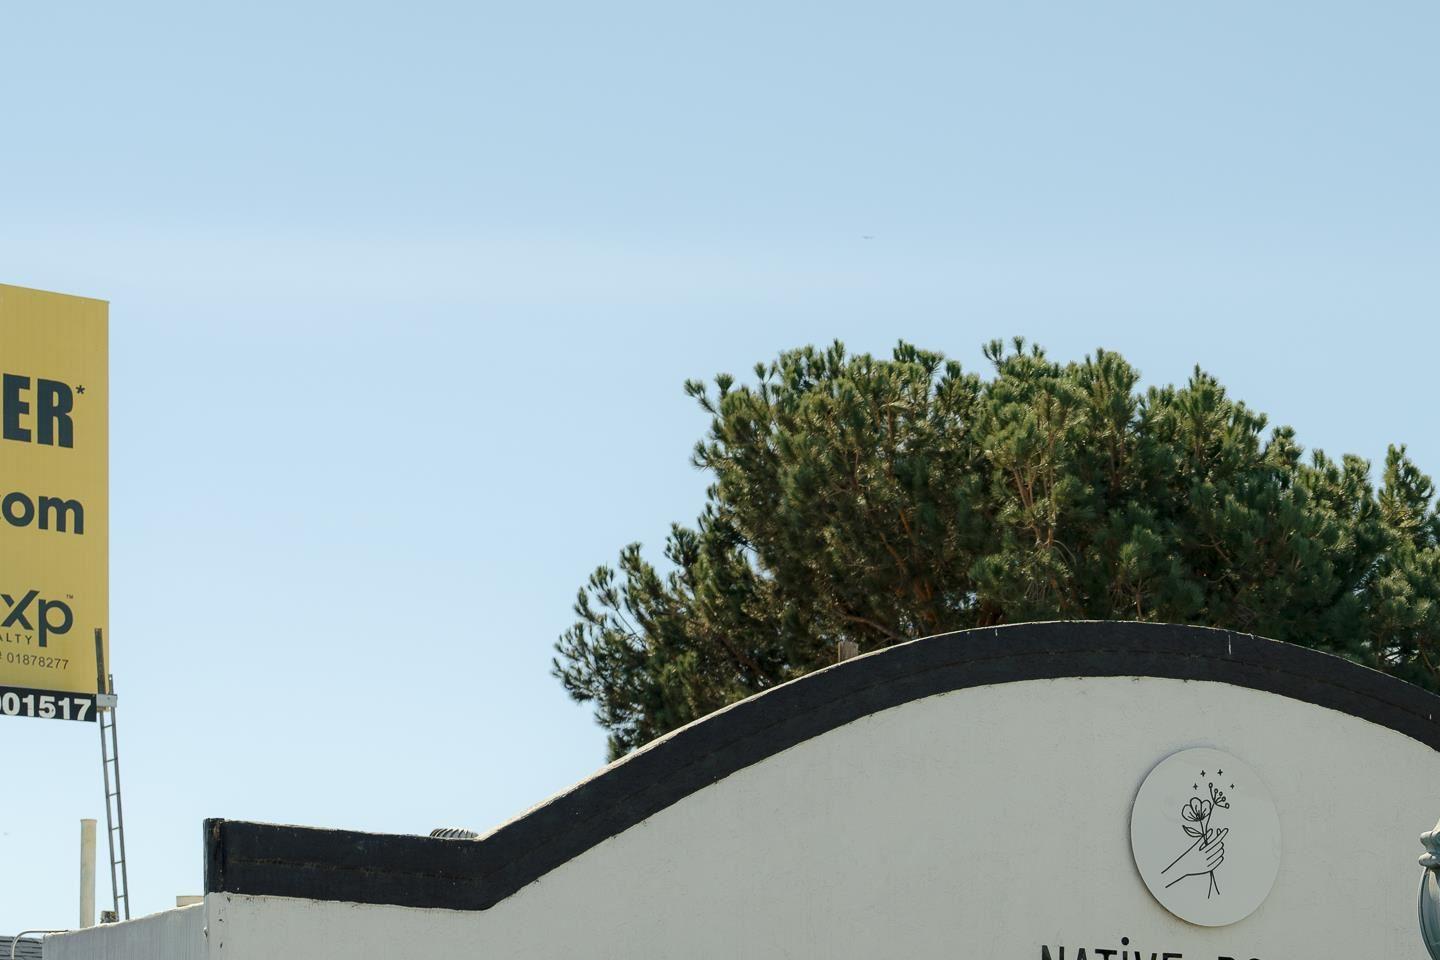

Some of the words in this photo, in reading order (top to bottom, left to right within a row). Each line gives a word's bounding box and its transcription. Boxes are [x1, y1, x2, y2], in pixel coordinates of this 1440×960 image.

[0, 493, 83, 535] om
[7, 652, 69, 670] 01878277
[0, 692, 91, 721] 01517
